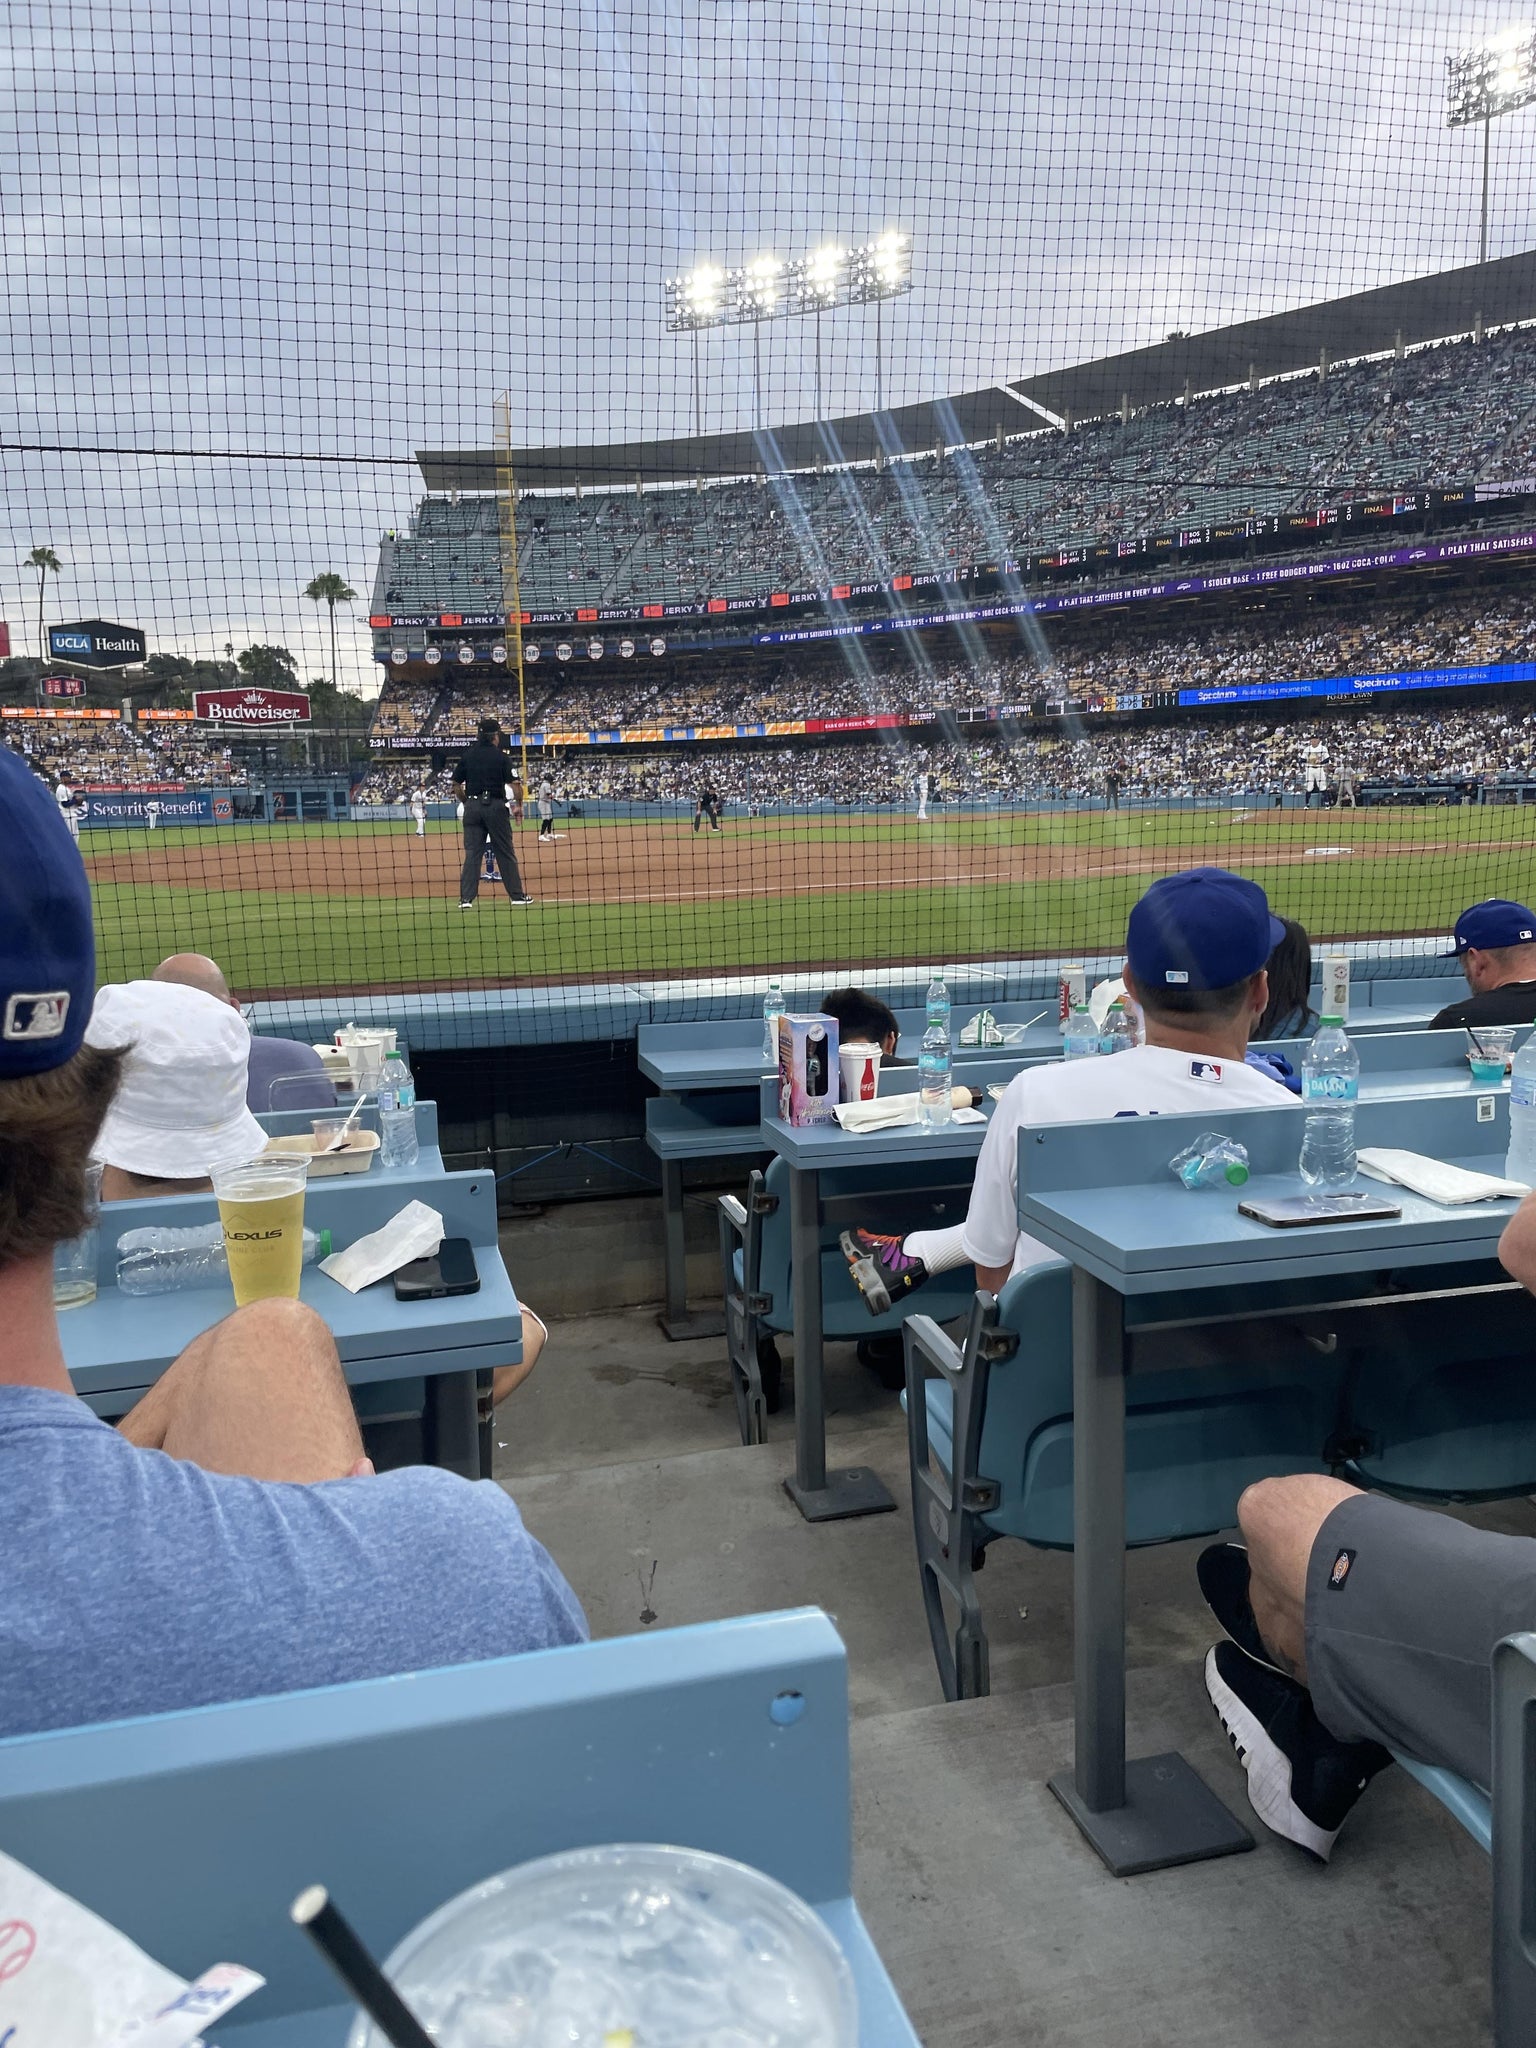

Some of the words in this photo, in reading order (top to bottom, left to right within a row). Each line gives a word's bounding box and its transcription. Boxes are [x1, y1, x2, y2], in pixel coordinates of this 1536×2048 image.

[1444, 492, 1464, 502] FINAL
[1347, 506, 1351, 514] 5
[1364, 505, 1384, 515] FINAL
[1290, 518, 1308, 526] FINAL
[1156, 539, 1172, 547] FINAL
[1440, 548, 1445, 556] A
[1448, 544, 1468, 556] PLAY
[1470, 541, 1490, 552] THAT
[1493, 536, 1533, 550] SATISFIES
[913, 575, 941, 586] JERKY
[1208, 577, 1231, 588] STOLEN
[1233, 575, 1249, 584] BASE
[1262, 571, 1278, 580] FREE
[1280, 567, 1307, 578] DODGER
[852, 584, 879, 596] JERKY
[791, 593, 817, 603] JERKY
[1064, 598, 1078, 607] PLAY
[1080, 596, 1093, 605] THAT
[1095, 592, 1122, 603] SATISFIES
[1133, 588, 1150, 598] EVERY
[1153, 586, 1165, 594] WAY
[728, 600, 756, 610] JERKY
[599, 610, 629, 619] JERKY
[664, 606, 693, 615] JERKY
[933, 615, 944, 623] FREE
[995, 606, 1024, 616] COCA-COLA
[393, 618, 425, 626] JERKY
[532, 614, 562, 622] JERKY
[810, 630, 832, 638] SATISFIES
[56, 638, 89, 649] UCLA
[95, 638, 140, 652] Health
[1354, 678, 1400, 690] Spectrum
[1406, 676, 1421, 684] Built
[1424, 675, 1434, 683] for
[1437, 674, 1449, 684] big
[1450, 673, 1487, 682] moments
[1198, 691, 1237, 702] Spectrum
[1268, 687, 1279, 696] big
[1280, 686, 1312, 694] moments
[369, 739, 386, 748] 2:34
[93, 802, 150, 818] Security
[156, 801, 203, 815] Benefit
[216, 803, 230, 814] 76
[1312, 1080, 1346, 1093] DASANI
[228, 1229, 282, 1241] LEXUS
